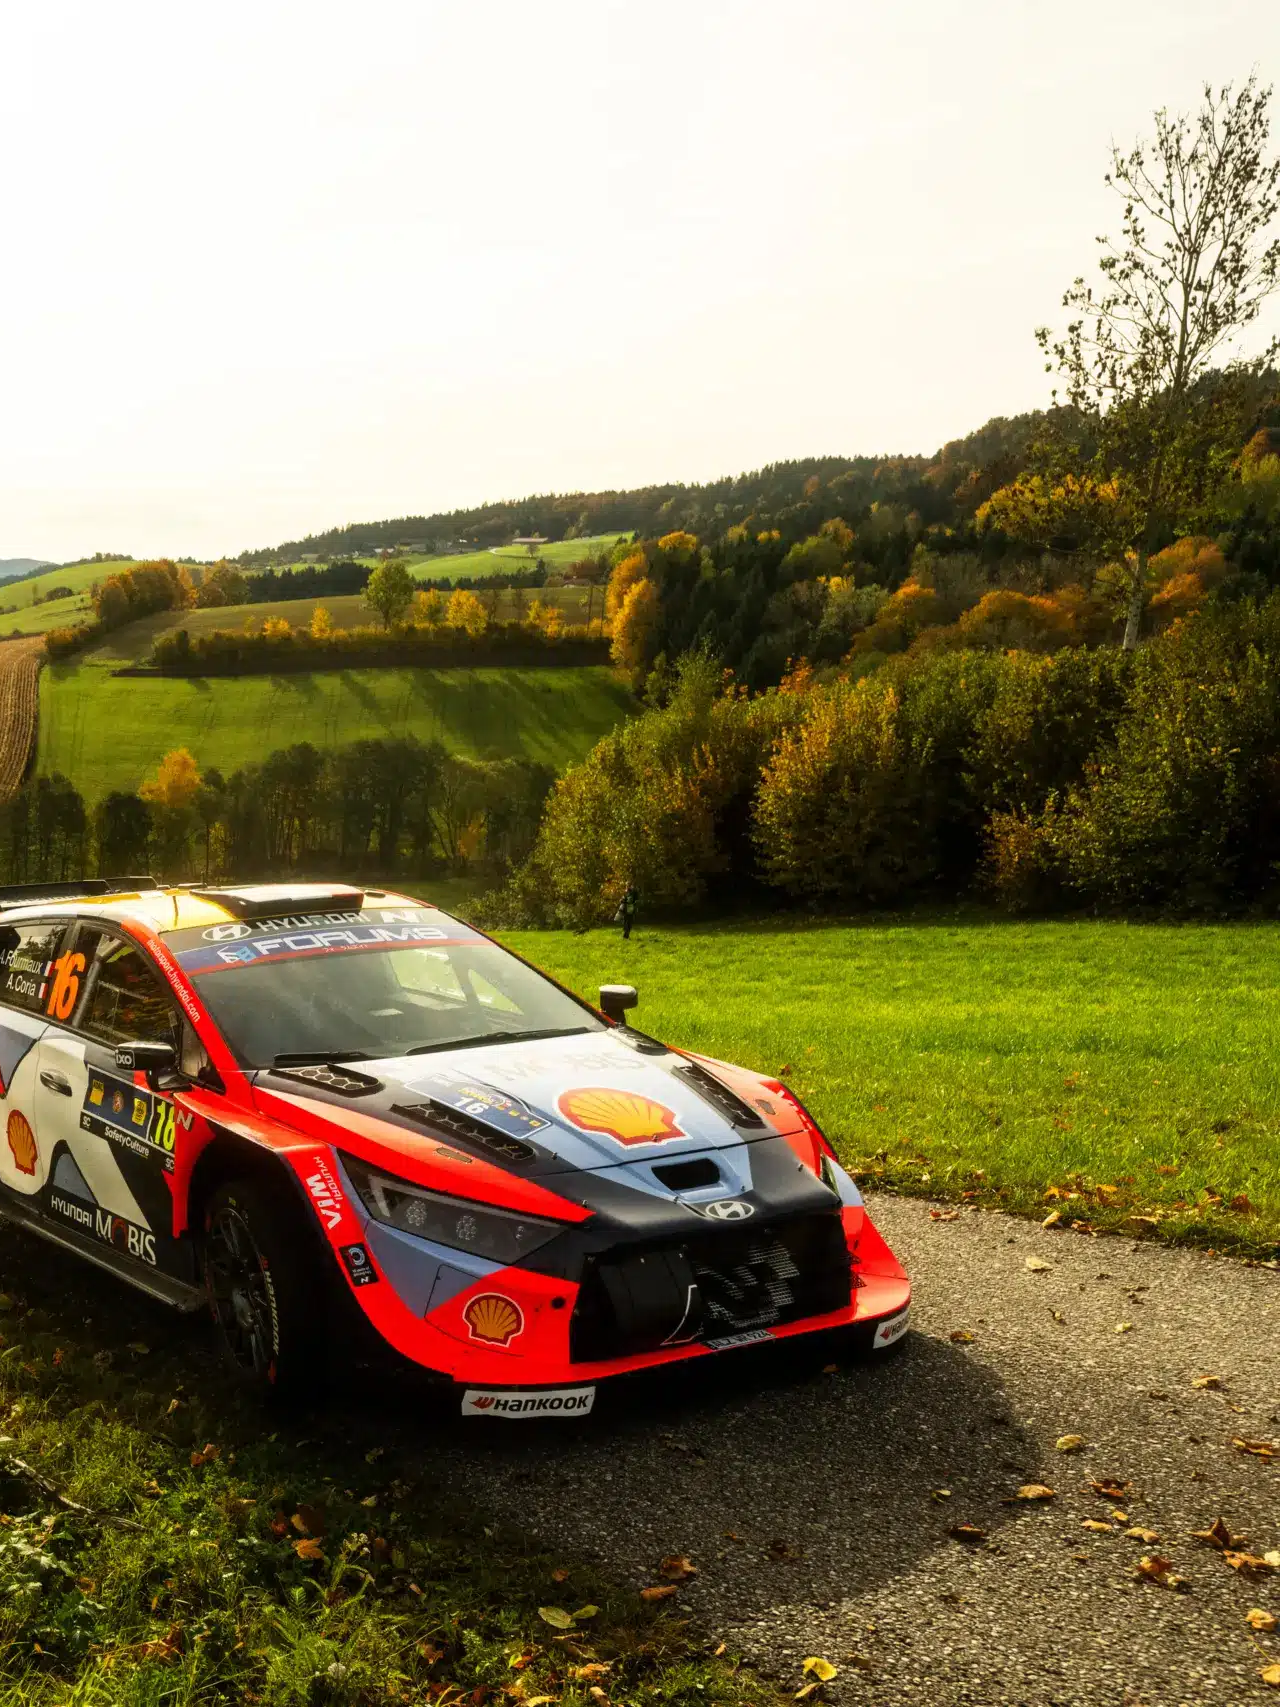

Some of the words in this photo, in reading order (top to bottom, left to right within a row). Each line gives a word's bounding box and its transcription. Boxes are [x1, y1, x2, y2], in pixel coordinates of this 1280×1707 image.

[258, 913, 372, 932] HYUNDAI
[381, 910, 421, 924] N
[252, 926, 448, 956] FORUM8
[47, 949, 86, 1021] 16
[147, 938, 201, 1023] motorsport.hyundai.com
[453, 1096, 490, 1115] 16
[104, 1126, 150, 1157] SafetyCulture
[313, 1156, 343, 1200] HYUNDAI
[51, 1195, 92, 1228] HYUNDAI
